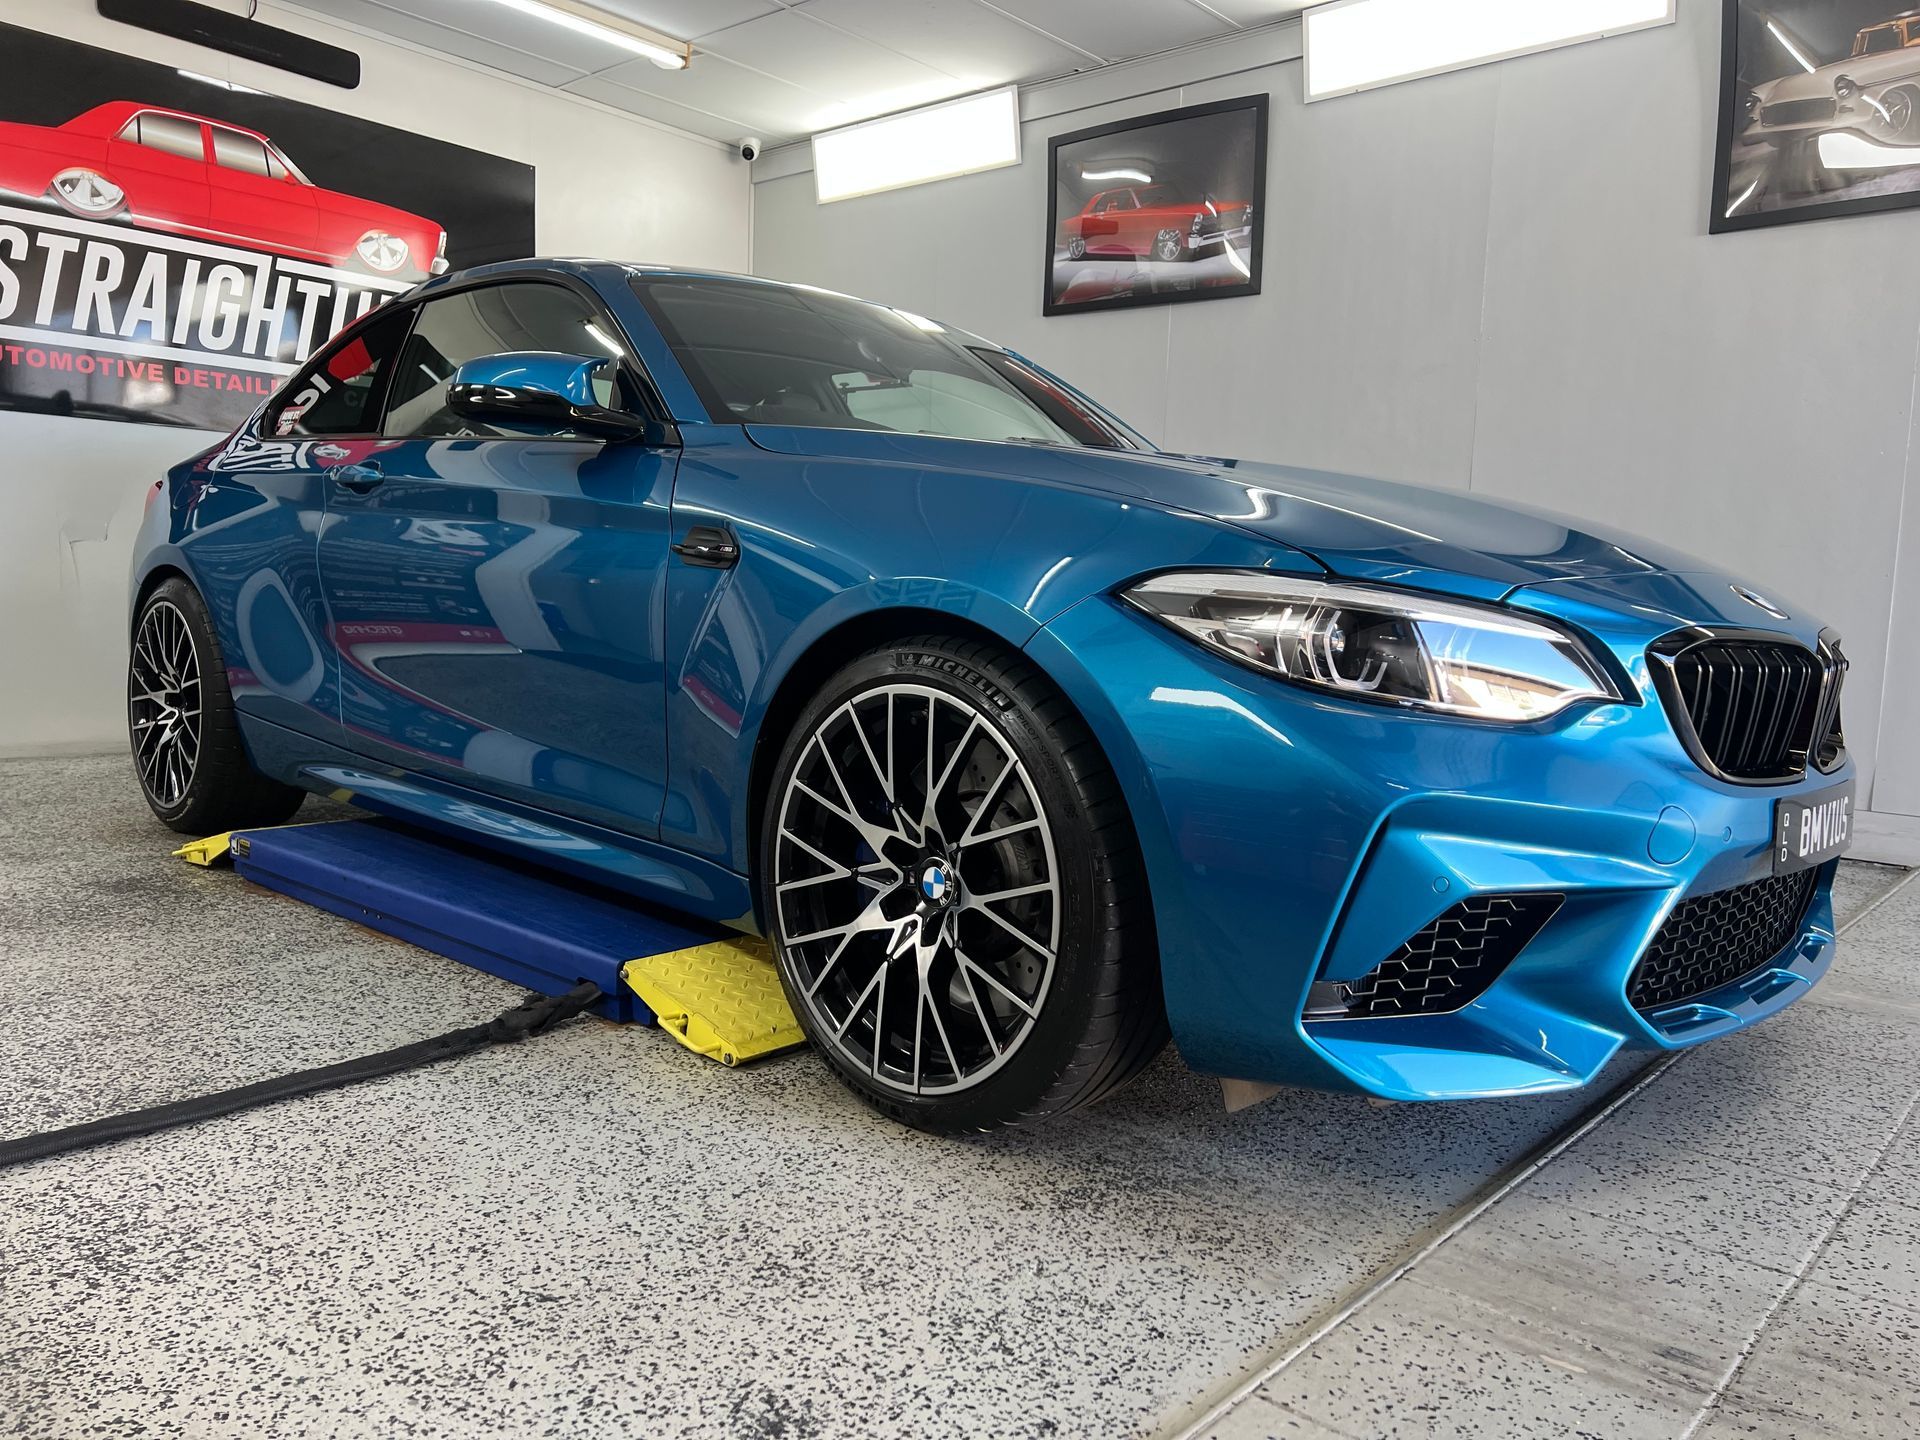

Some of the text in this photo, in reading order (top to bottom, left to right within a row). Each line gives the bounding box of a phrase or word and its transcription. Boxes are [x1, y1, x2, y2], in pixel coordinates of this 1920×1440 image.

[0, 345, 163, 383] TOMOTIVE
[919, 655, 1010, 706] MICHELIN
[1017, 712, 1040, 741] PILOT
[1781, 813, 1790, 862] QLD
[939, 864, 952, 906] BMW
